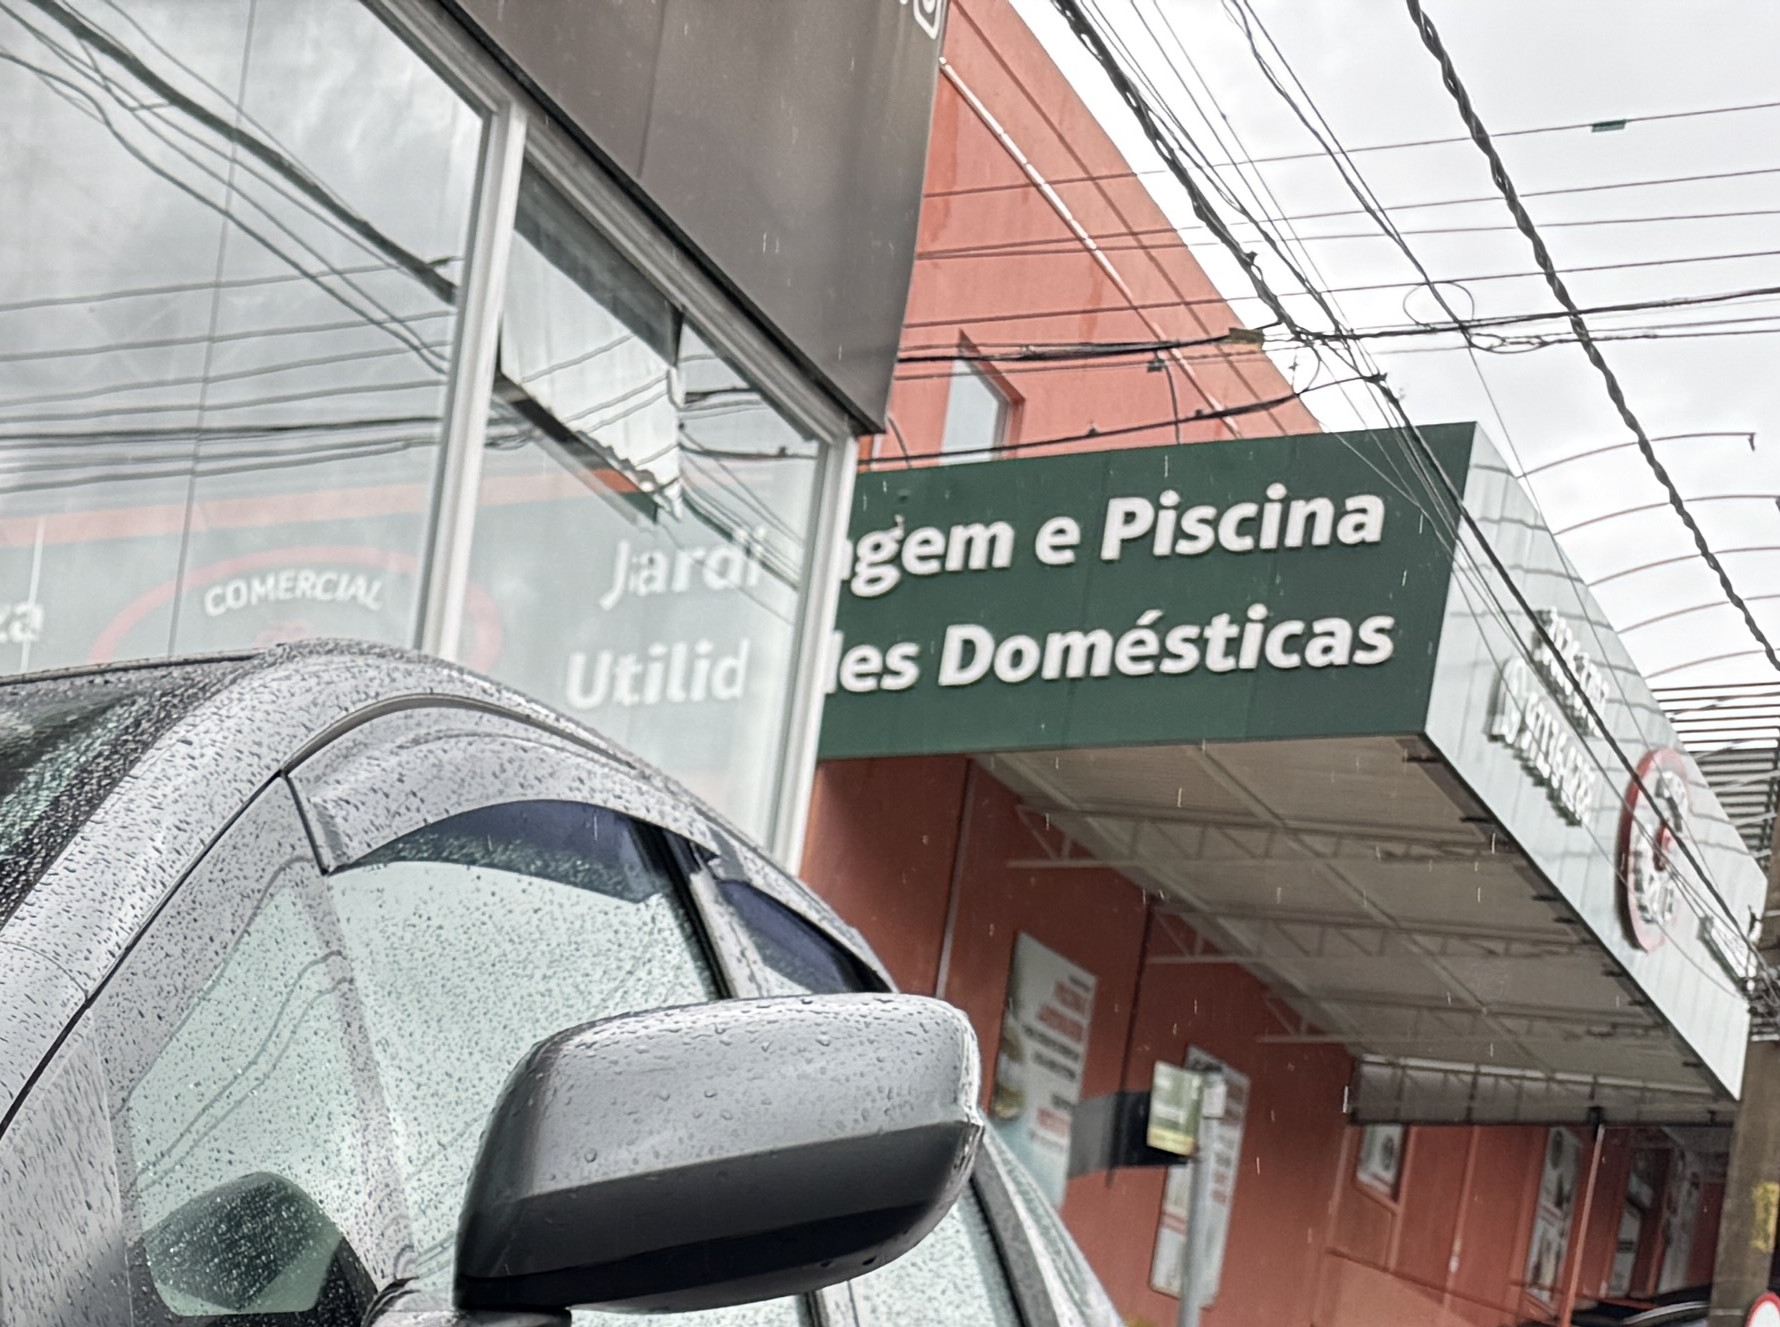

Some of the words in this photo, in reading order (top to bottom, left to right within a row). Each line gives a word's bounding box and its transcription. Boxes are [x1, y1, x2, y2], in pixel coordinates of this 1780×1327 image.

[1034, 515, 1081, 566] e
[1099, 481, 1386, 561] Piscina
[204, 568, 384, 618] COMERCIAL
[938, 602, 1396, 687] Domésticas
